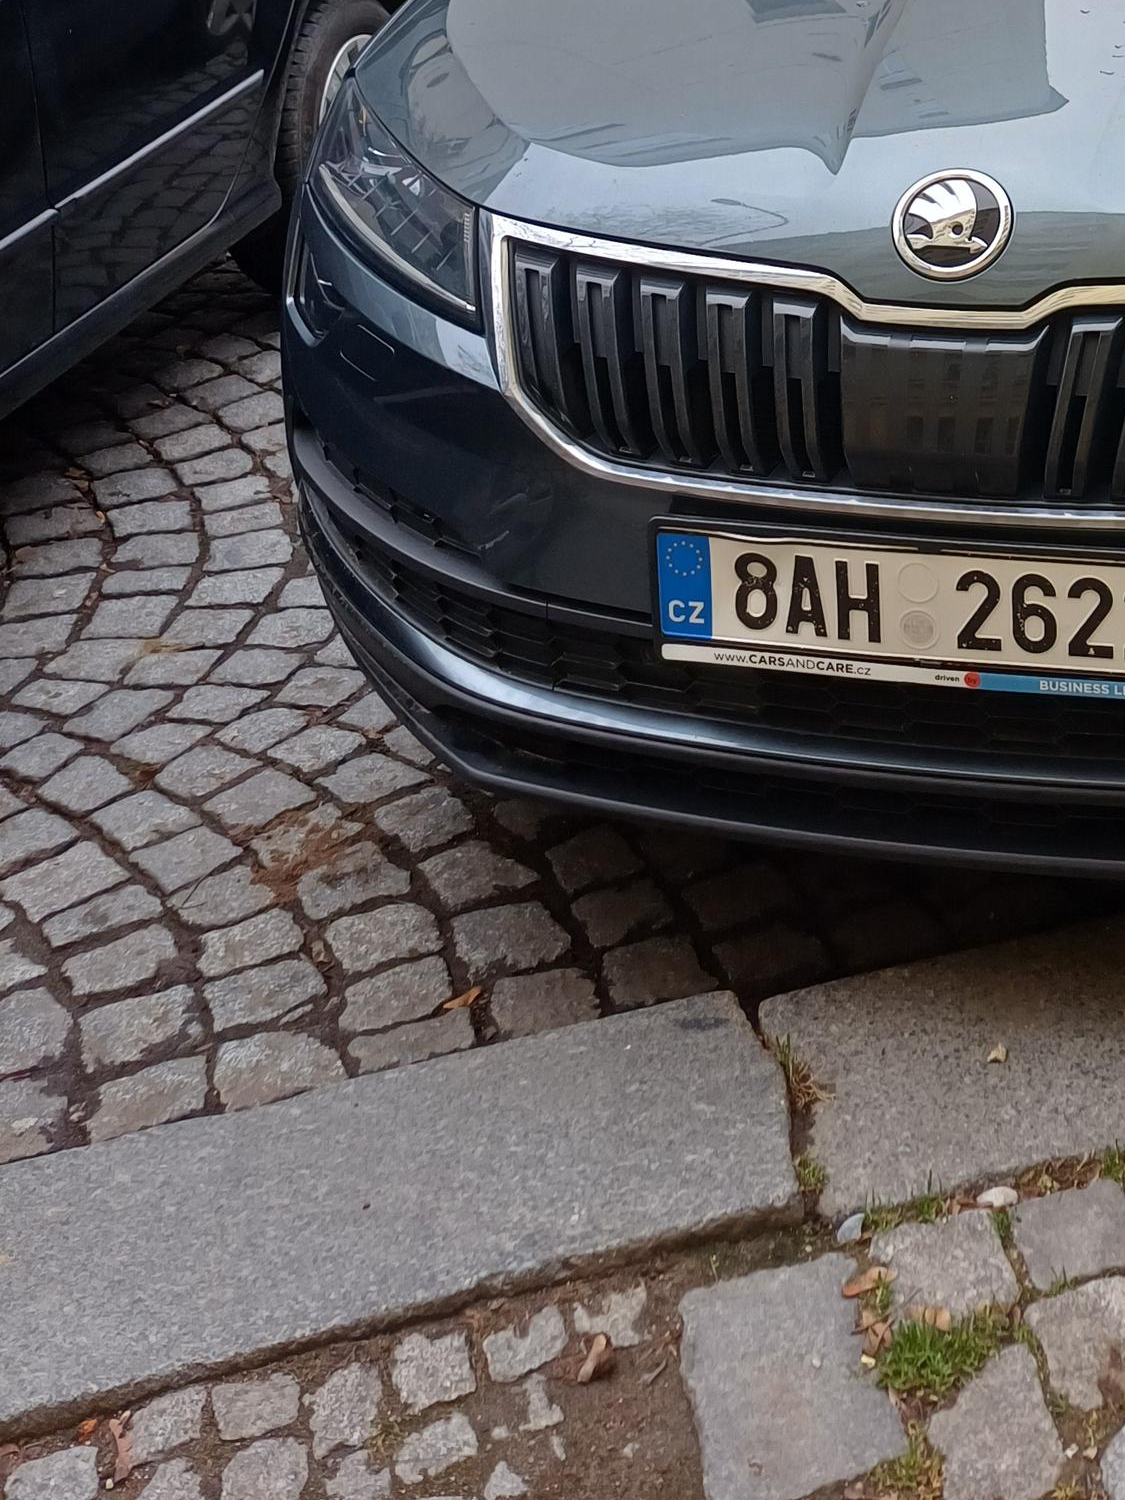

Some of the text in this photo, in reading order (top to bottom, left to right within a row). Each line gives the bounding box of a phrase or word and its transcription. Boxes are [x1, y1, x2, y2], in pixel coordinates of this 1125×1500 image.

[734, 552, 882, 643] 8AH
[668, 599, 705, 625] CZ
[934, 674, 960, 683] driven
[1039, 680, 1110, 695] BUSINESS
